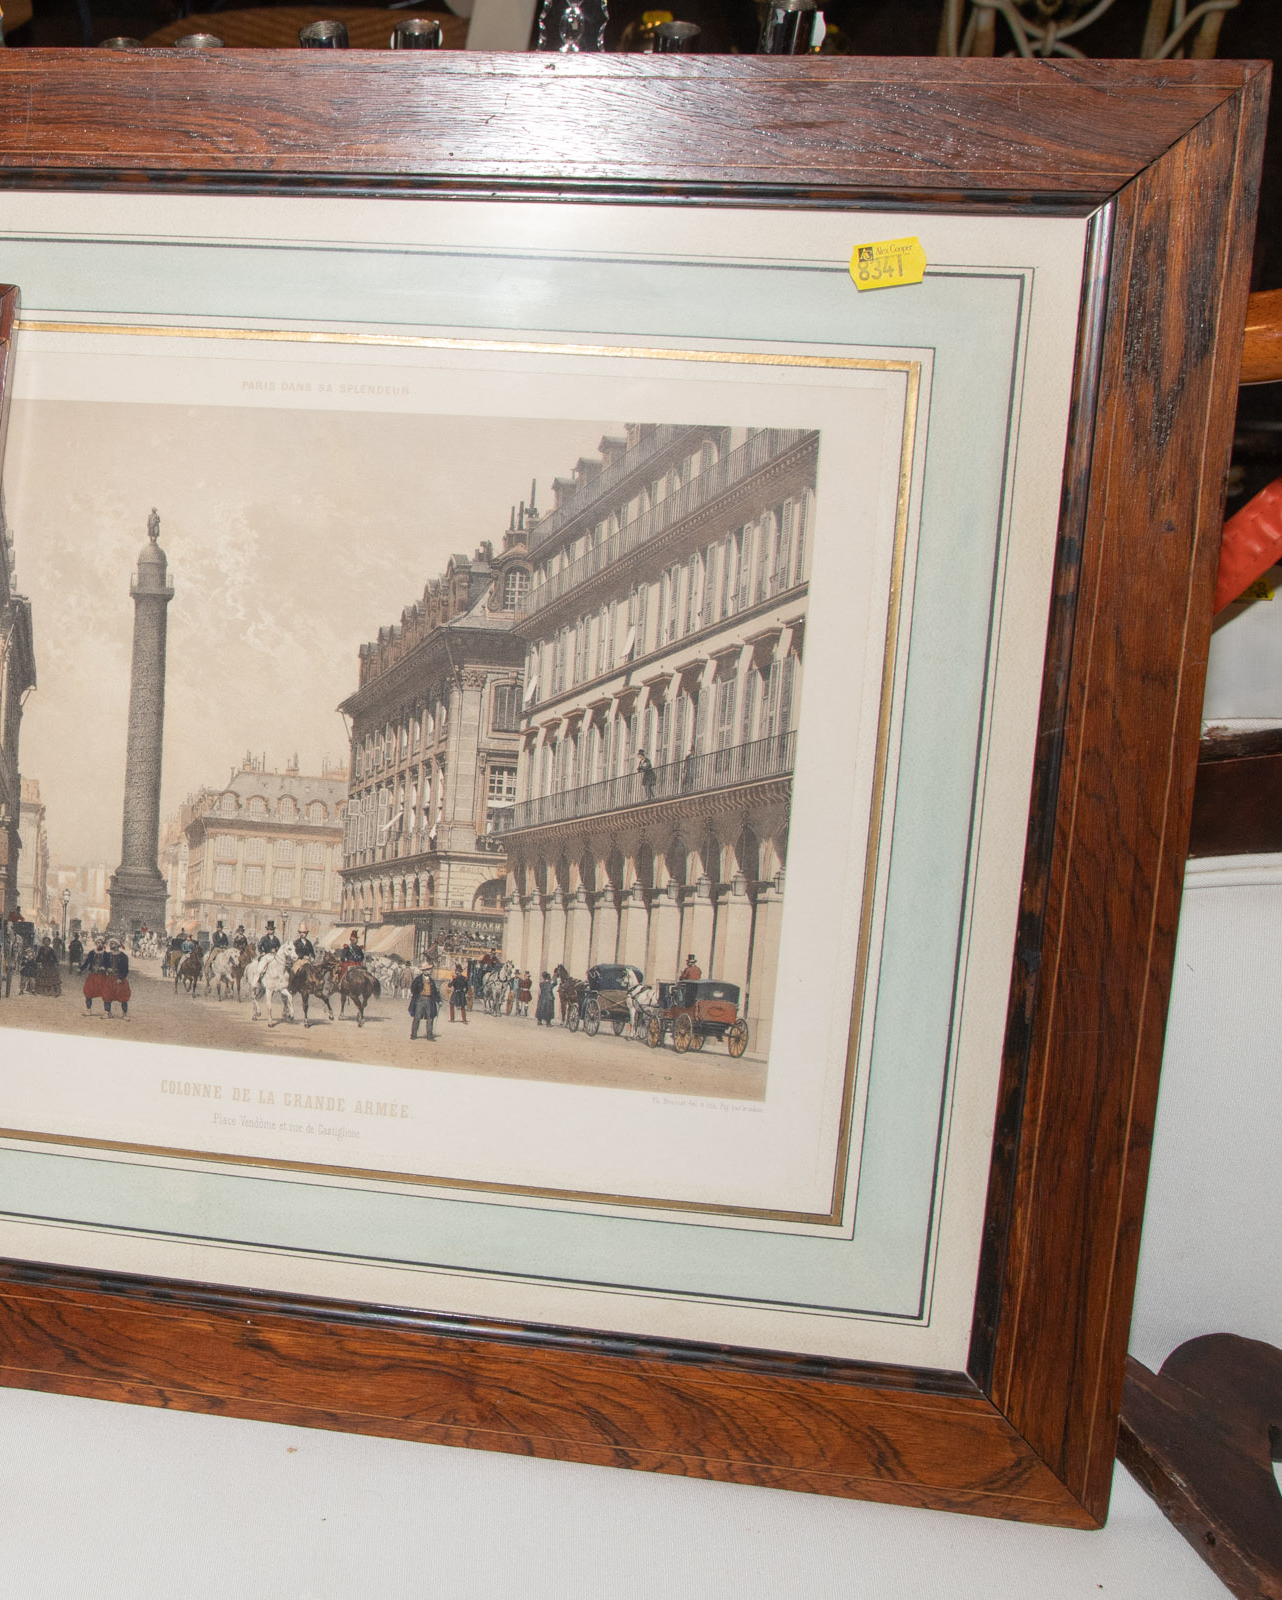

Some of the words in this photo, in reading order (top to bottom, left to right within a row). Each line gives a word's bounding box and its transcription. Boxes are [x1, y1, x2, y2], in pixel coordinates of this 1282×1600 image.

[889, 243, 913, 255] Cooper
[858, 255, 904, 281] 8341
[241, 380, 276, 391] PARIS
[281, 381, 312, 392] DANS
[318, 383, 333, 393] SA
[160, 1079, 223, 1100] COLONNE
[232, 1086, 251, 1103] DE
[258, 1089, 275, 1105] LA
[283, 1092, 346, 1113] GRANDE
[212, 1112, 236, 1127] Place
[279, 1121, 288, 1132] et
[289, 1123, 304, 1134] rue
[306, 1122, 315, 1135] de
[318, 1123, 361, 1141] Castiglione
